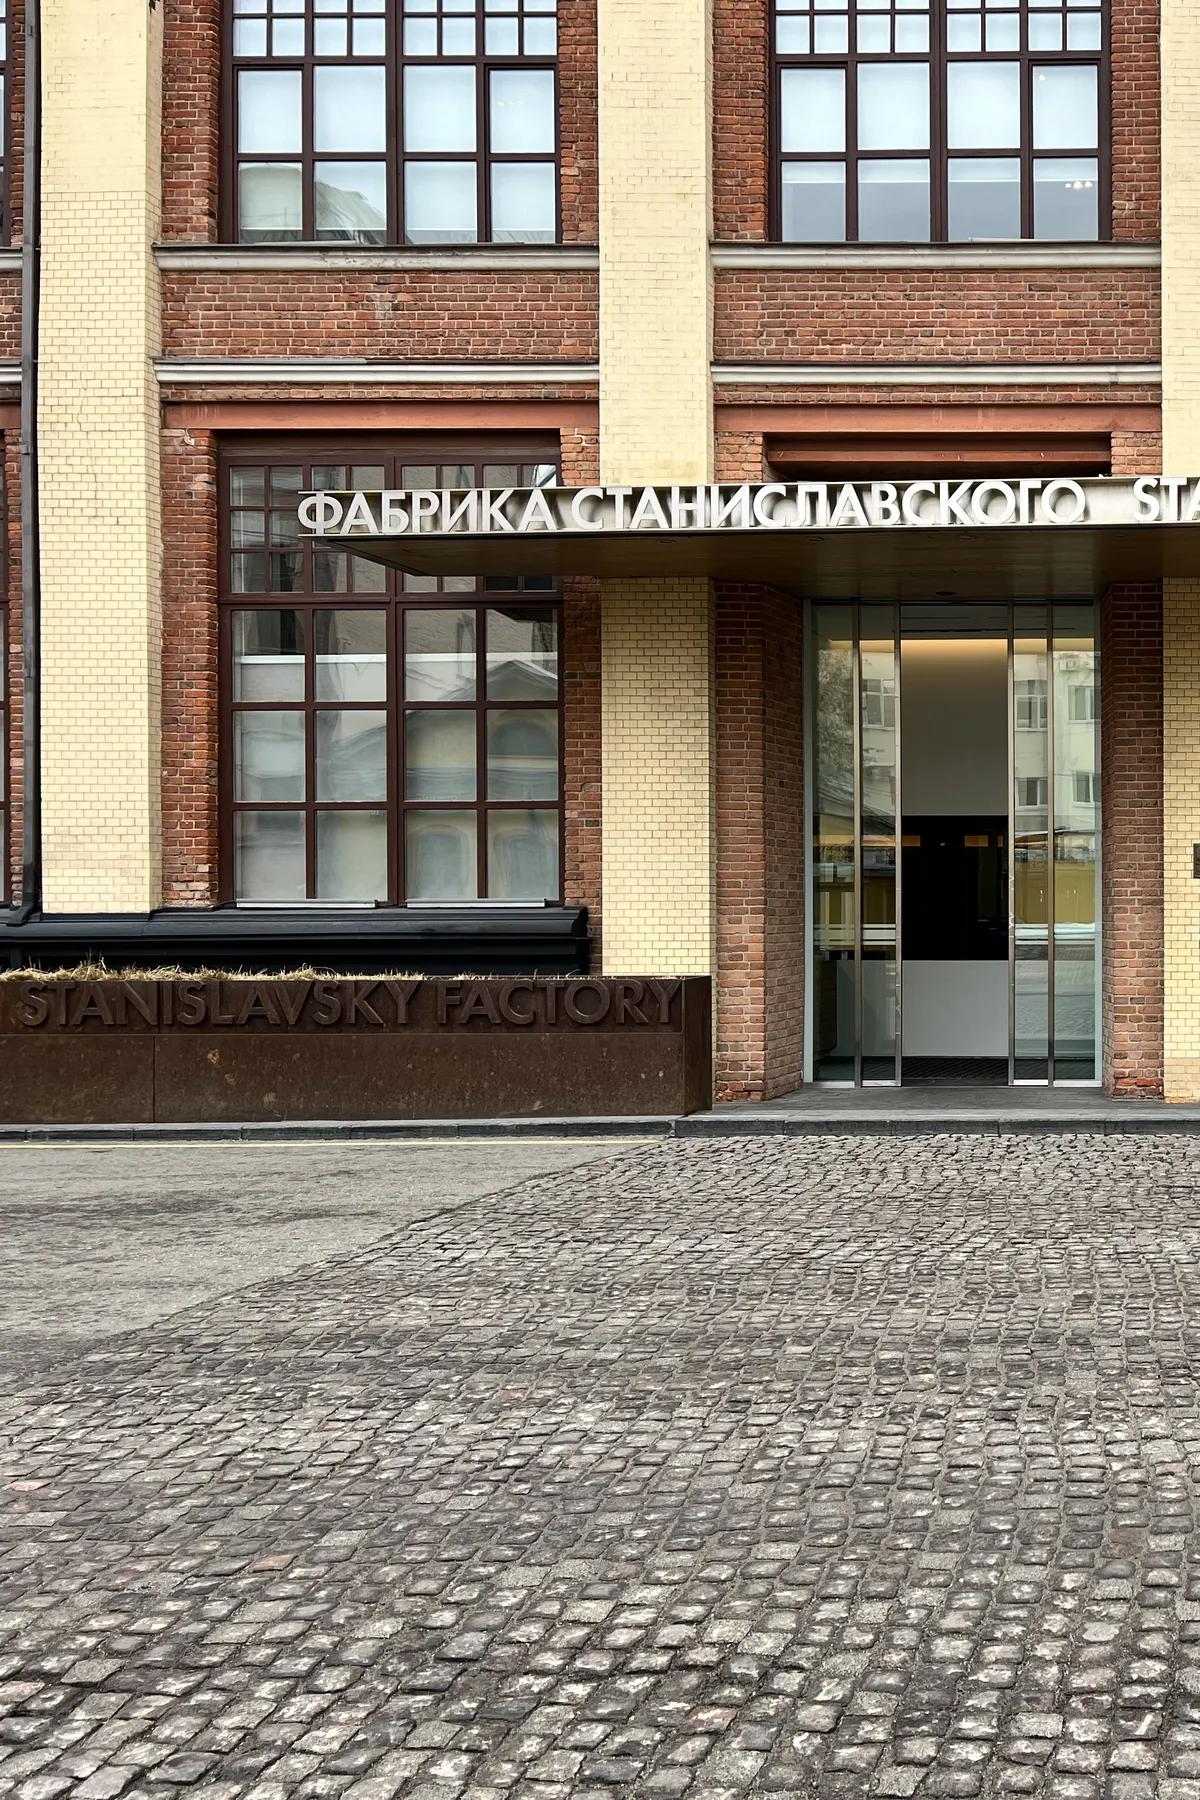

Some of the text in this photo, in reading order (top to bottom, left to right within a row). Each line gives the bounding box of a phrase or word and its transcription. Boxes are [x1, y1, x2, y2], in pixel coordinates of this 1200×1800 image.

[298, 480, 1086, 535] ФАБРИКА СТАНИСЛАВСКОГО
[19, 979, 683, 1026] STANISLAVSKY FACTORY
